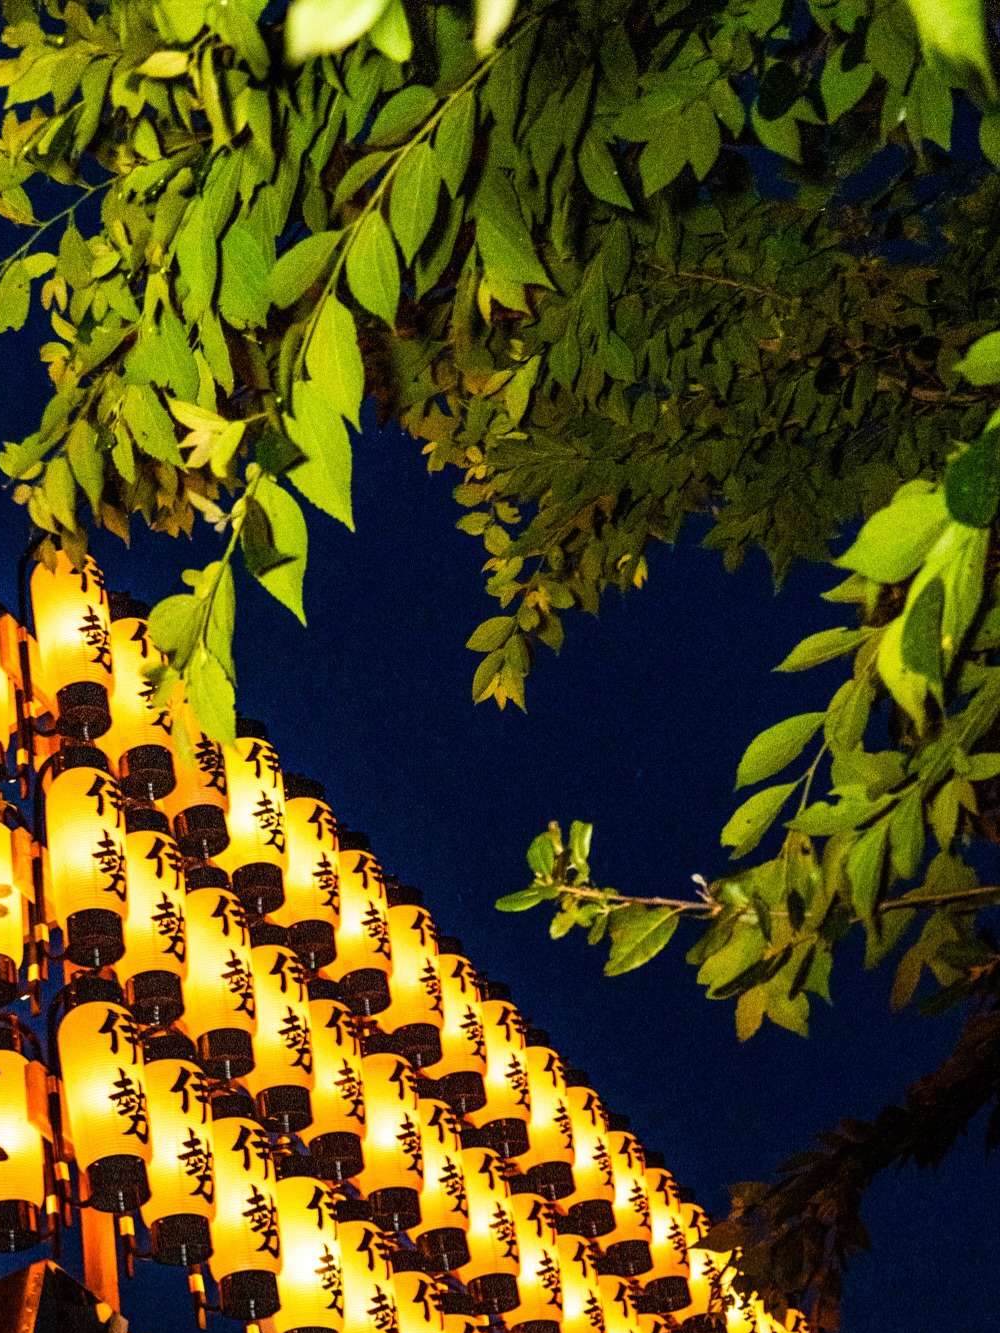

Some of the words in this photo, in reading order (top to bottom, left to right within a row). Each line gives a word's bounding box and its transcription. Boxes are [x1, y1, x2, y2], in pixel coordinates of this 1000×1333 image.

[86, 774, 126, 902] 伊勢
[245, 742, 285, 854] 伊勢
[145, 837, 185, 963] 伊勢
[307, 803, 340, 915] 伊勢
[352, 853, 391, 961] 伊勢
[211, 895, 255, 1019] 伊勢
[269, 952, 312, 1074] 伊勢
[411, 910, 444, 1018] 伊勢
[451, 960, 487, 1064] 伊勢
[98, 1008, 150, 1144] 伊勢
[325, 1006, 365, 1124] 伊勢
[496, 1006, 531, 1112] 伊勢
[543, 1054, 575, 1151] 伊勢
[170, 1066, 214, 1204] 伊勢
[389, 1060, 423, 1178] 伊勢
[428, 1104, 468, 1218] 伊勢
[583, 1092, 615, 1190] 伊勢
[232, 1124, 280, 1259] 伊勢
[478, 1153, 519, 1264] 伊勢
[619, 1136, 651, 1229] 伊勢
[656, 1174, 690, 1267] 伊勢
[307, 1186, 343, 1318] 伊勢
[527, 1200, 563, 1311] 伊勢
